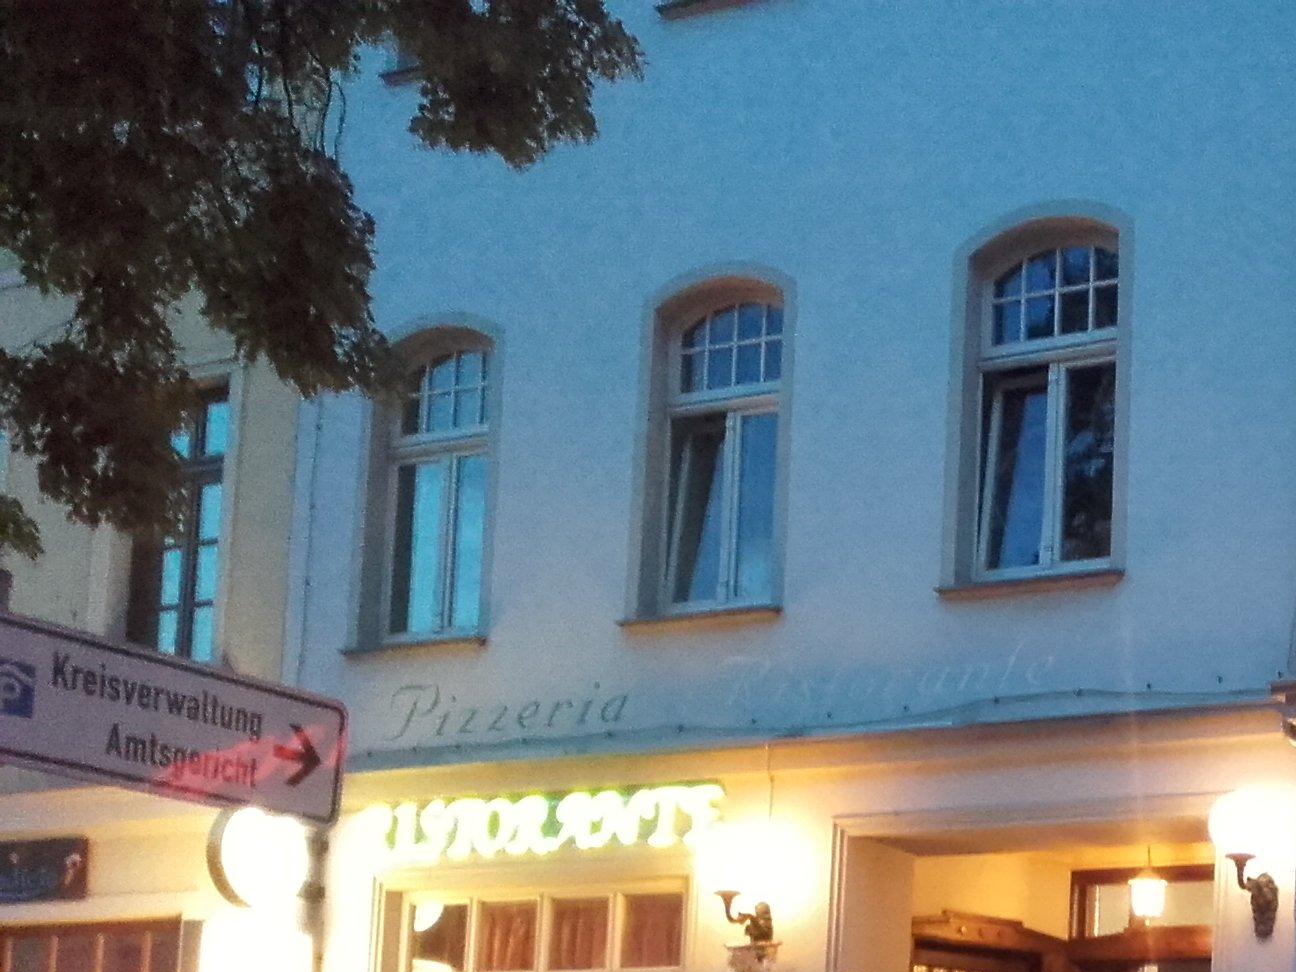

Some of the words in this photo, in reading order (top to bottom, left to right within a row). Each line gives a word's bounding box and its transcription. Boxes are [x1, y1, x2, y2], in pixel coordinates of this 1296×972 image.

[50, 650, 265, 742] Kreisverwaltung
[382, 680, 629, 742] Pizzeria
[105, 722, 259, 788] Amtsgericht
